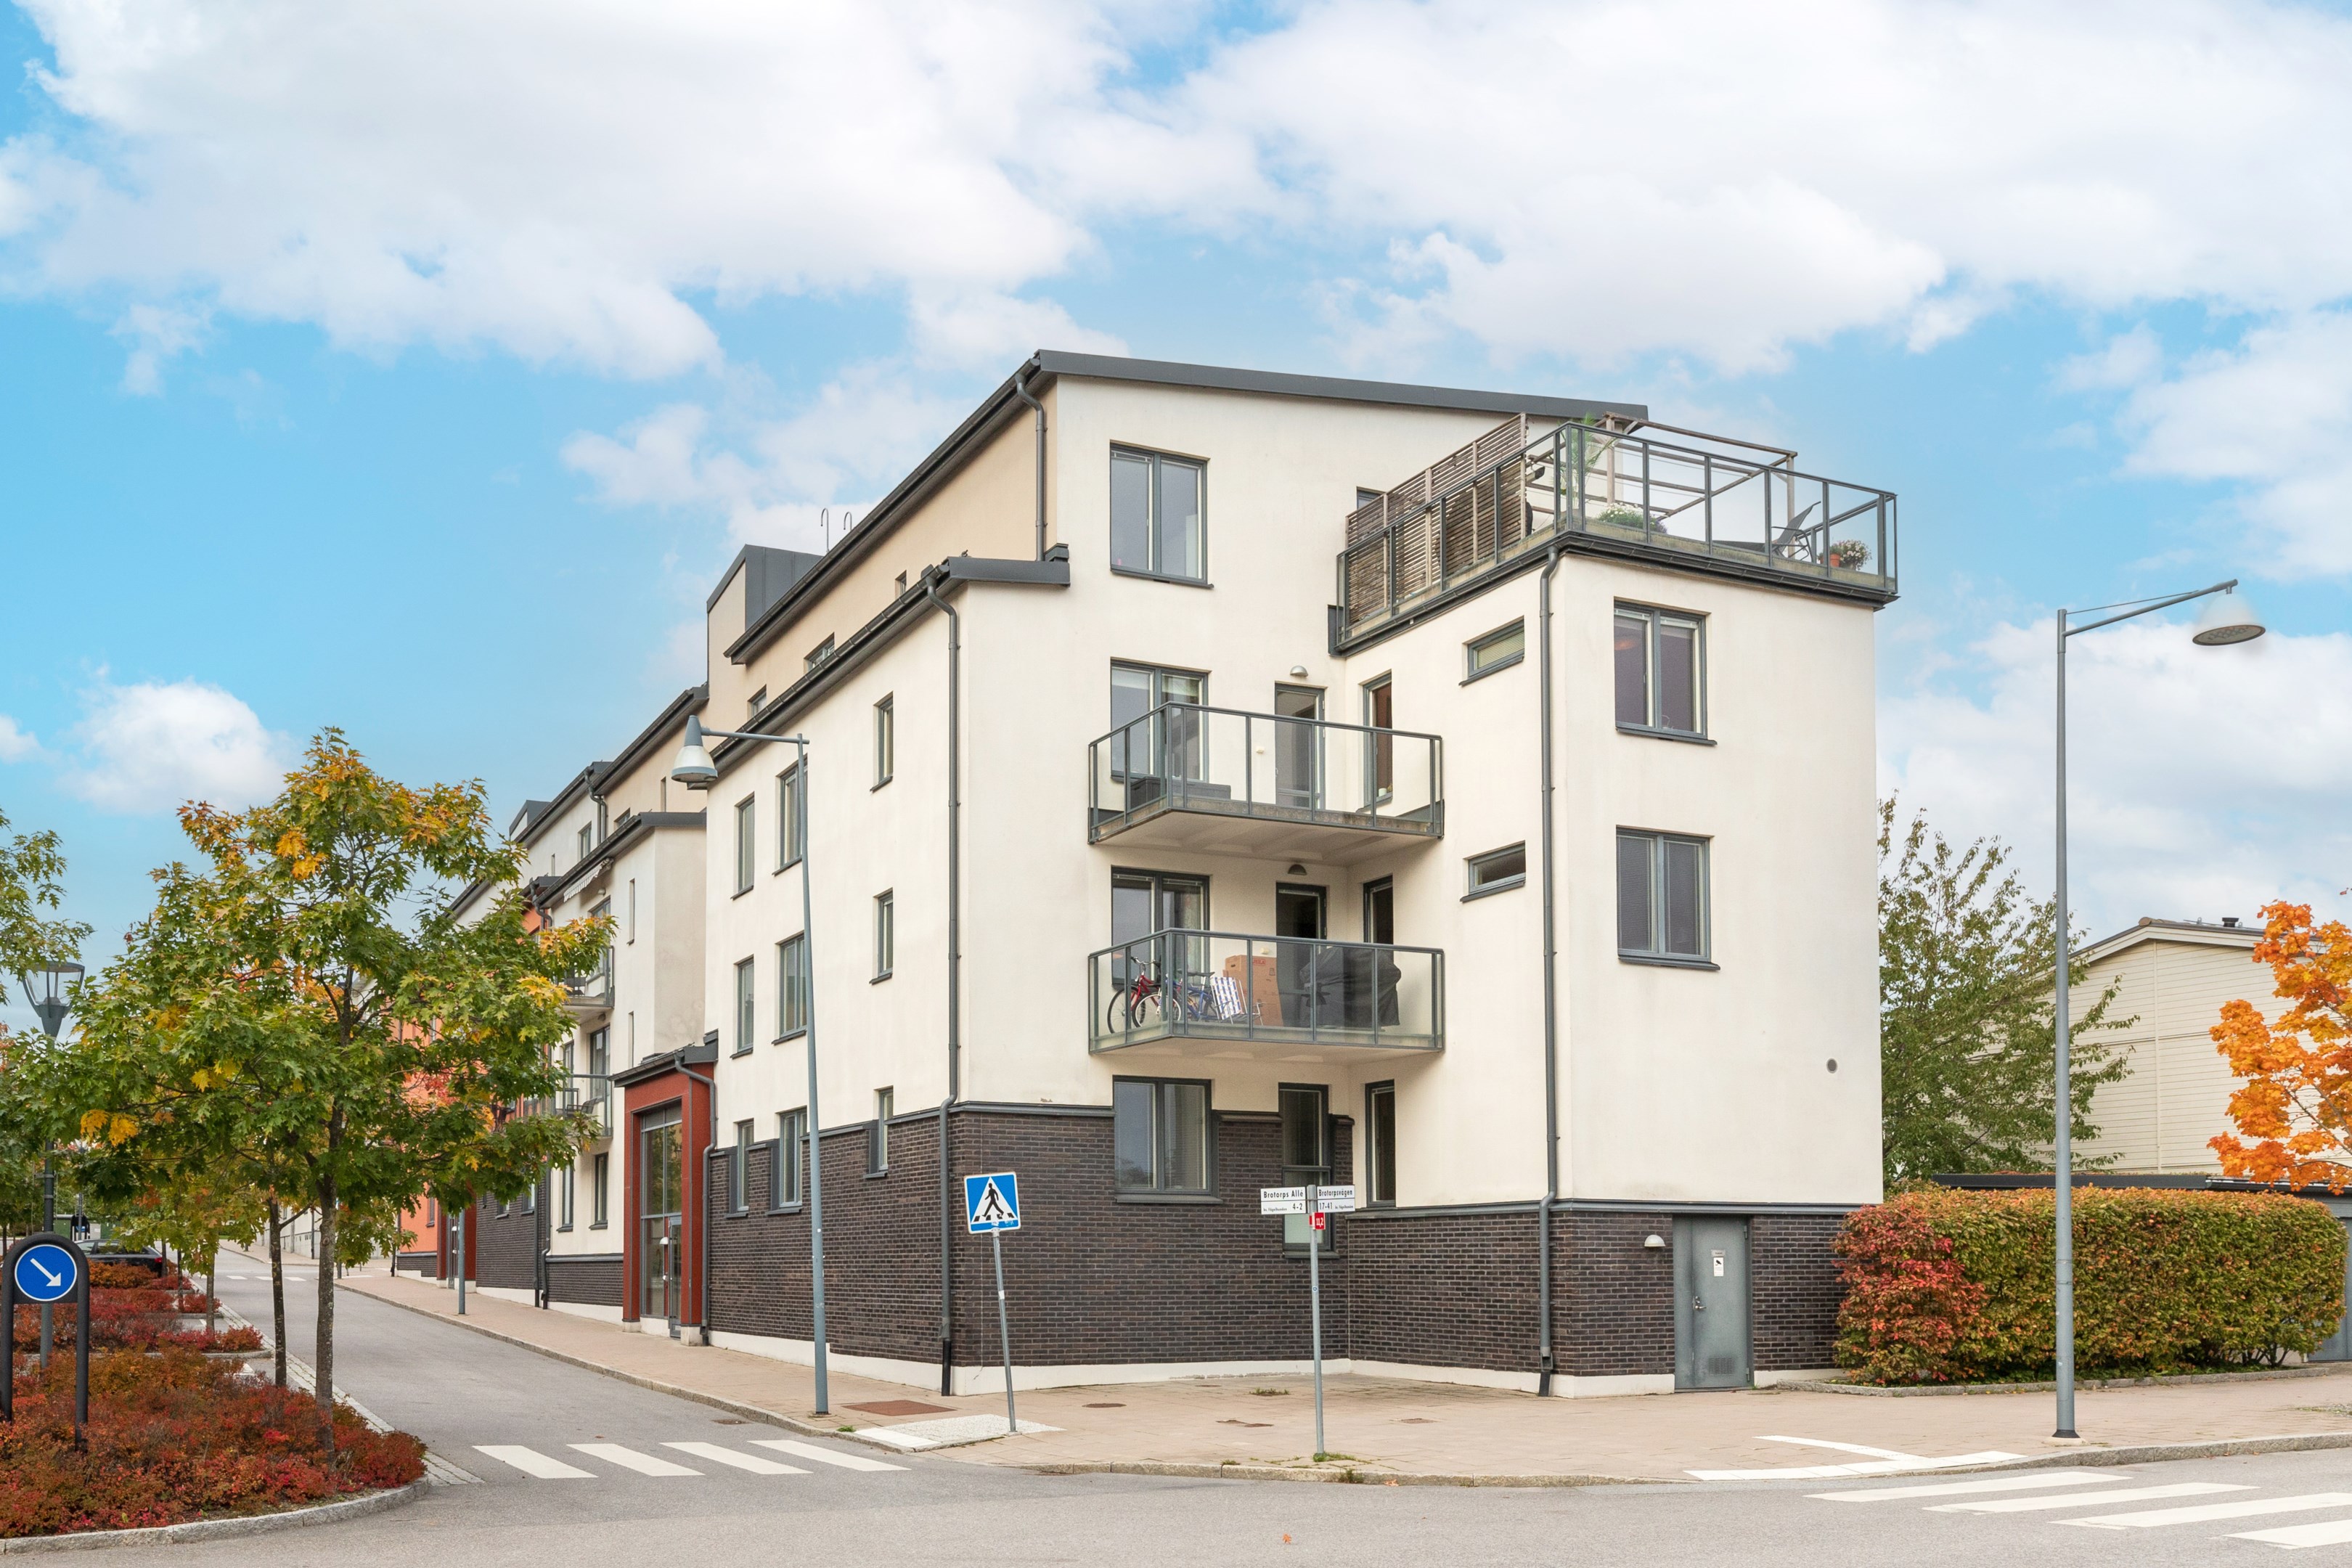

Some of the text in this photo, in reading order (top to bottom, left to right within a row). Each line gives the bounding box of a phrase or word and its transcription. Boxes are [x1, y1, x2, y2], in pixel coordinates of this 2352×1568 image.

[1264, 1189, 1304, 1199] Brotorps Allé
[1318, 1188, 1353, 1198] Brotorpsvägen
[1319, 1201, 1333, 1210] 17-41
